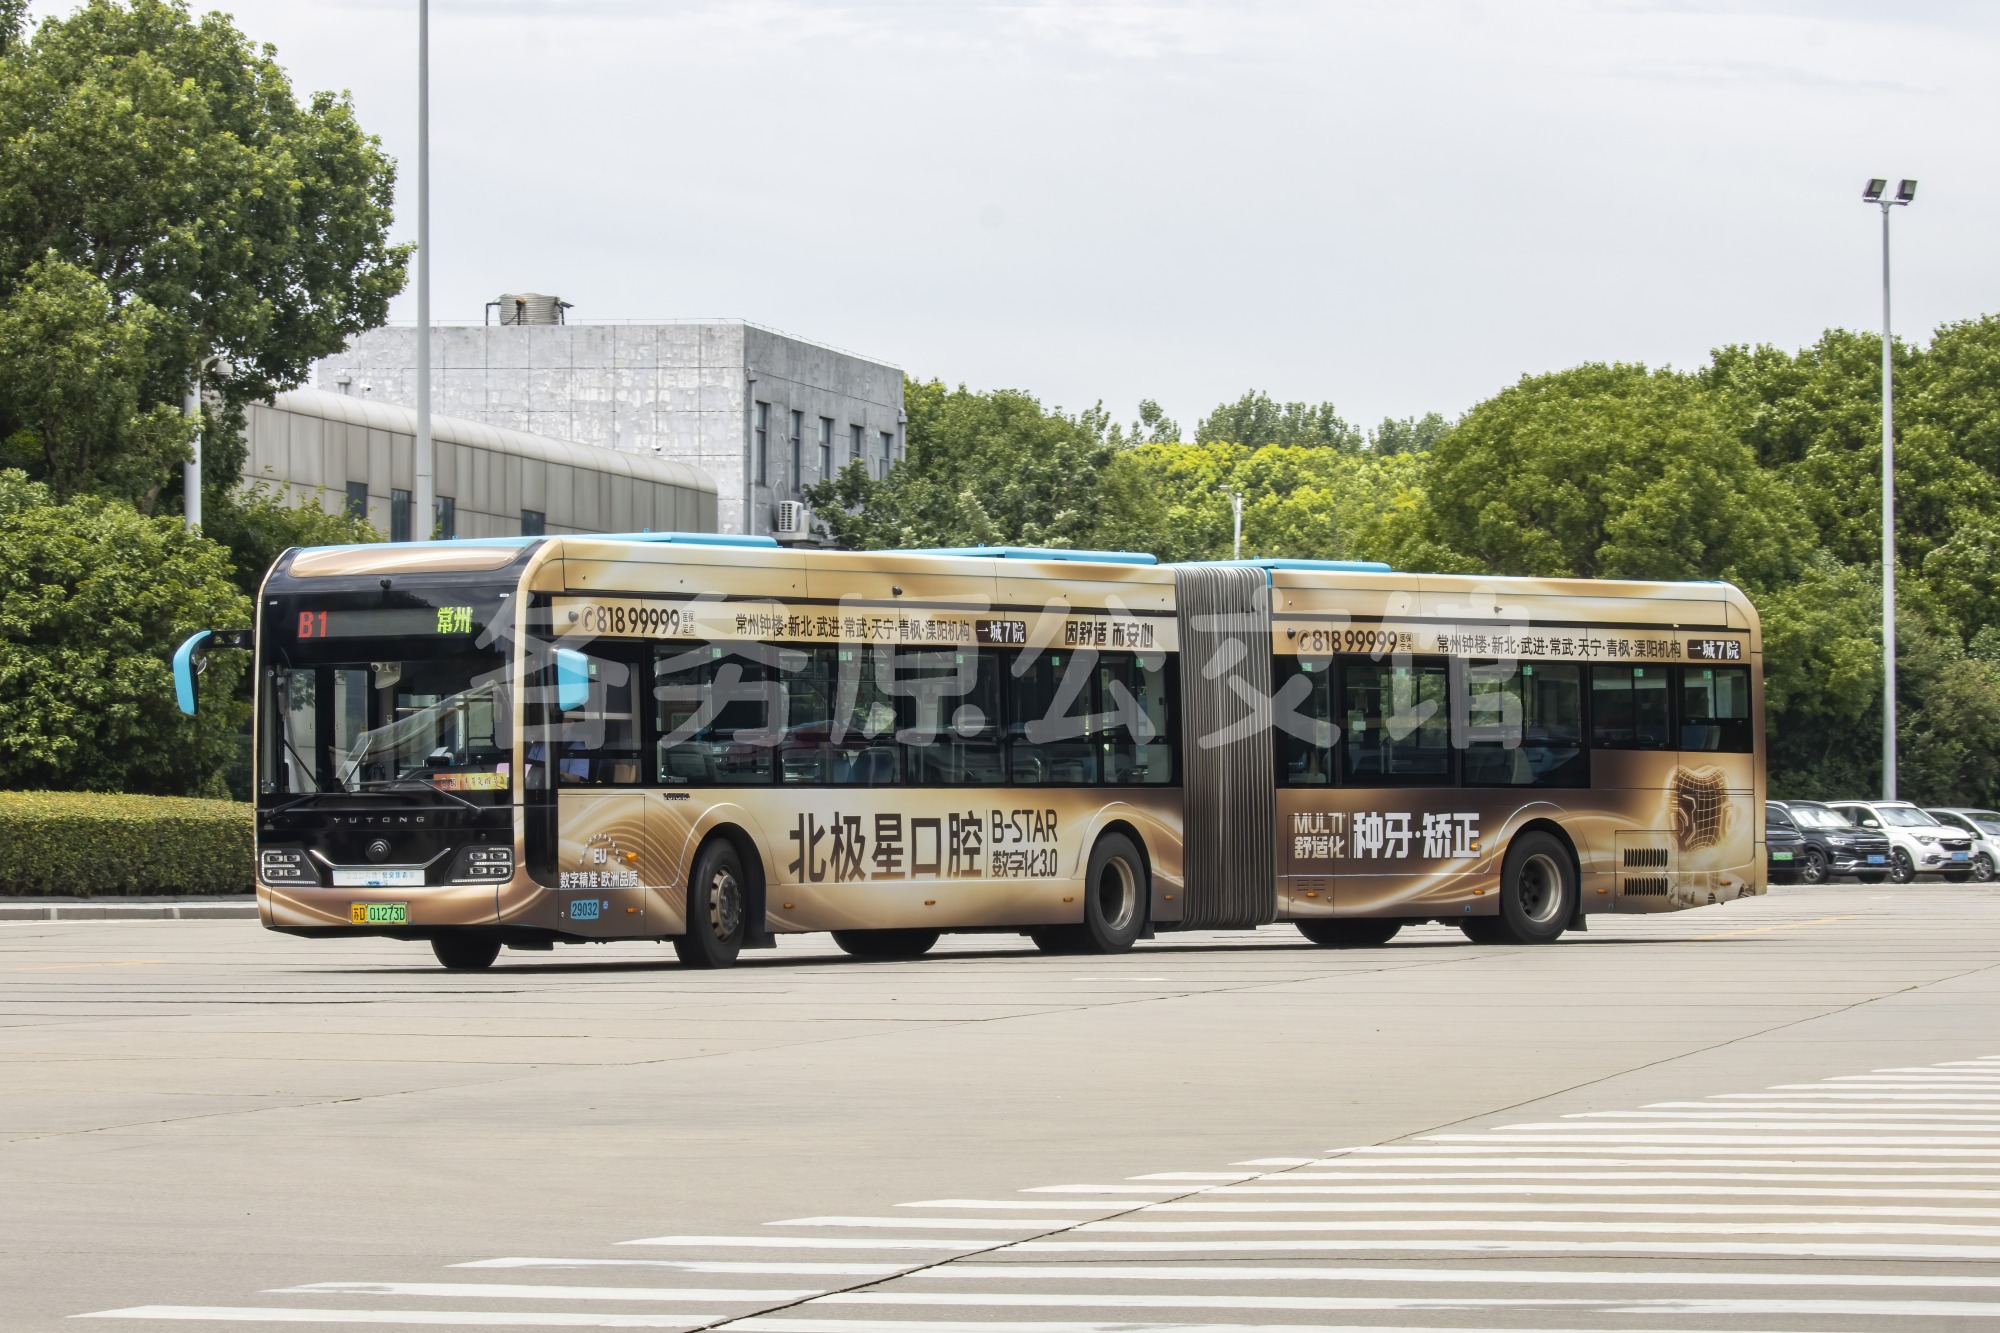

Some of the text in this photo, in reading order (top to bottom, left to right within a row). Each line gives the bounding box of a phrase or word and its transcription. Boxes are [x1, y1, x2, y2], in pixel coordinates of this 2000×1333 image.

[299, 611, 327, 638] B1
[437, 606, 472, 634] 常州
[597, 606, 680, 635] 818 99999
[977, 620, 1025, 644] 一城7院
[1313, 629, 1397, 653] 818 99999
[1688, 640, 1740, 661] 一城7院
[333, 816, 425, 824] YUTONG
[991, 809, 1058, 843] B-STAR
[788, 810, 983, 883] 北极星口腔
[1353, 811, 1481, 859] 种牙·矫正
[593, 848, 607, 864] EU
[1294, 836, 1345, 859] 舒适化
[991, 848, 1058, 878] 数字化3.0
[560, 870, 638, 888] 数字精准·欧洲品质
[571, 902, 598, 917] 29032
